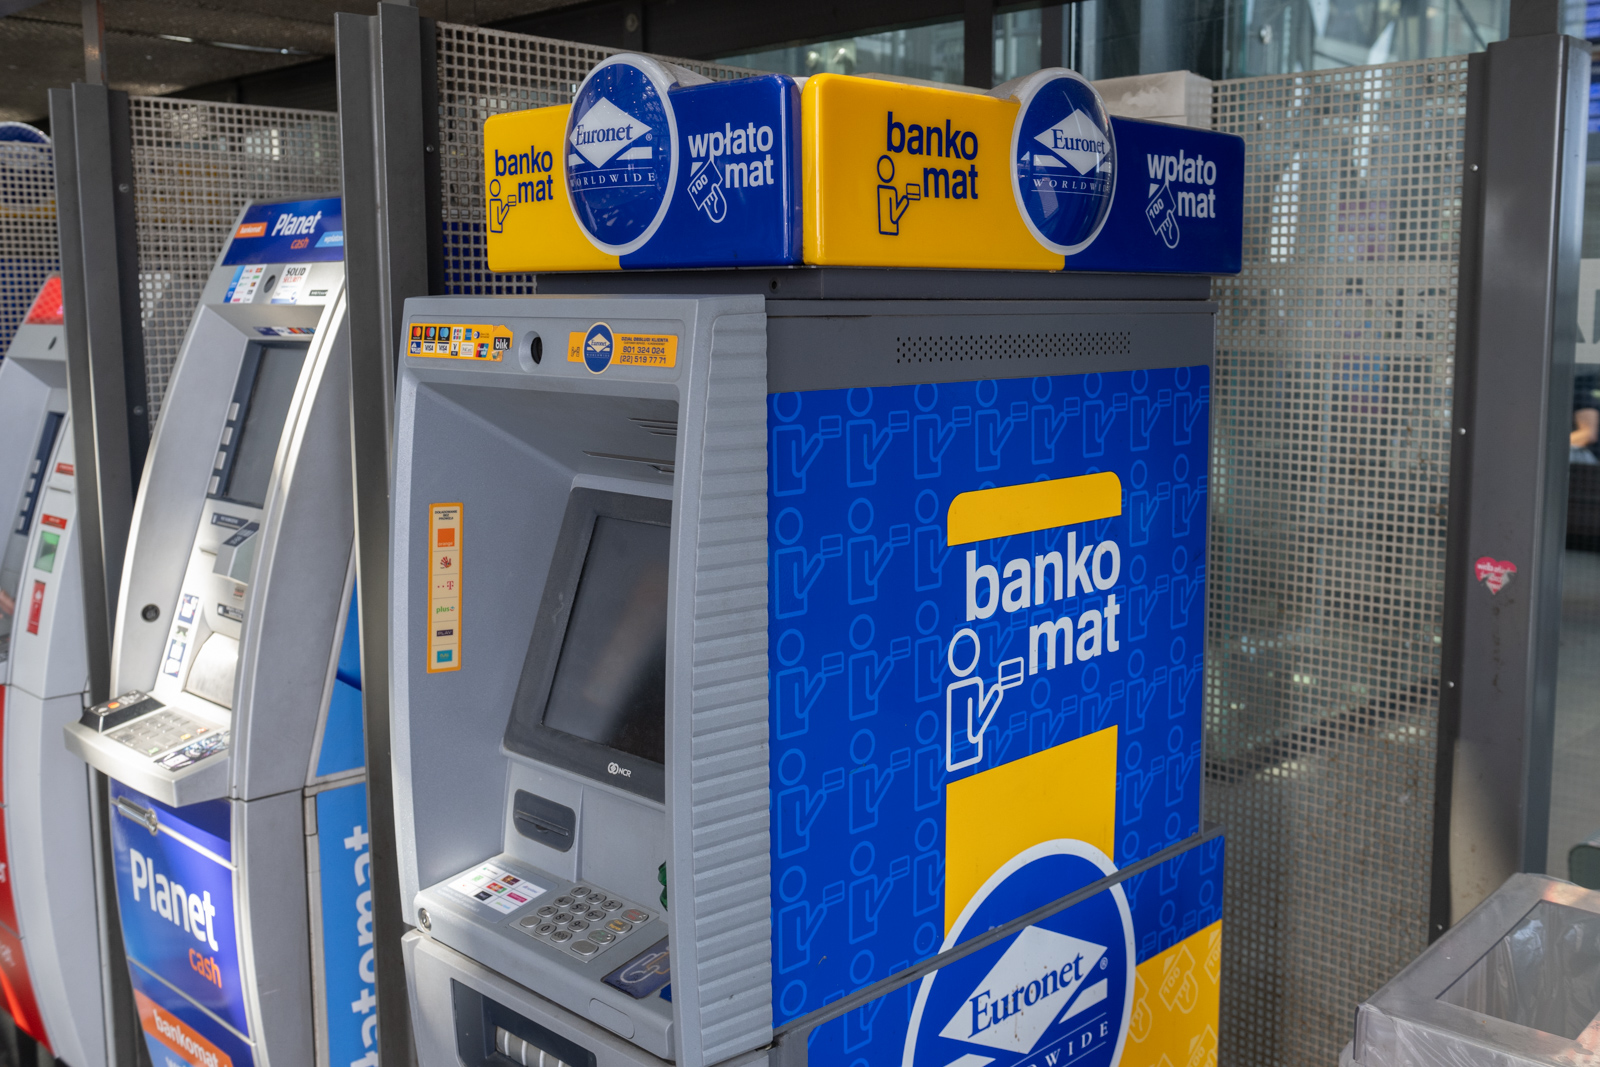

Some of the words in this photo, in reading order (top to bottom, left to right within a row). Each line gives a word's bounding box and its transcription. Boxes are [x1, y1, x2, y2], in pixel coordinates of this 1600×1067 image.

[575, 123, 634, 146] Euronet
[687, 121, 774, 158] wpłato
[888, 111, 979, 160] banko
[1050, 128, 1106, 154] Euronet
[494, 145, 554, 177] banko
[725, 154, 774, 188] mat
[1147, 148, 1217, 185] wpłato
[517, 175, 554, 204] mat
[691, 173, 709, 195] 100
[923, 164, 979, 200] mat
[1149, 198, 1165, 219] 100
[1177, 187, 1217, 219] mat
[271, 210, 322, 237] Planet
[290, 237, 310, 250] cash
[286, 267, 307, 276] SOLID
[495, 338, 508, 350] blik
[637, 346, 650, 354] 324
[620, 355, 633, 364] (22)
[634, 356, 648, 364] 519
[966, 531, 1121, 622] banko
[436, 605, 450, 614] plus
[1029, 593, 1121, 676] mat
[618, 767, 632, 778] NCR
[130, 848, 219, 952] Planet
[188, 948, 222, 988] cash
[1163, 967, 1181, 994] 100
[967, 951, 1084, 1039] Euronet
[152, 1008, 219, 1067] bankomat
